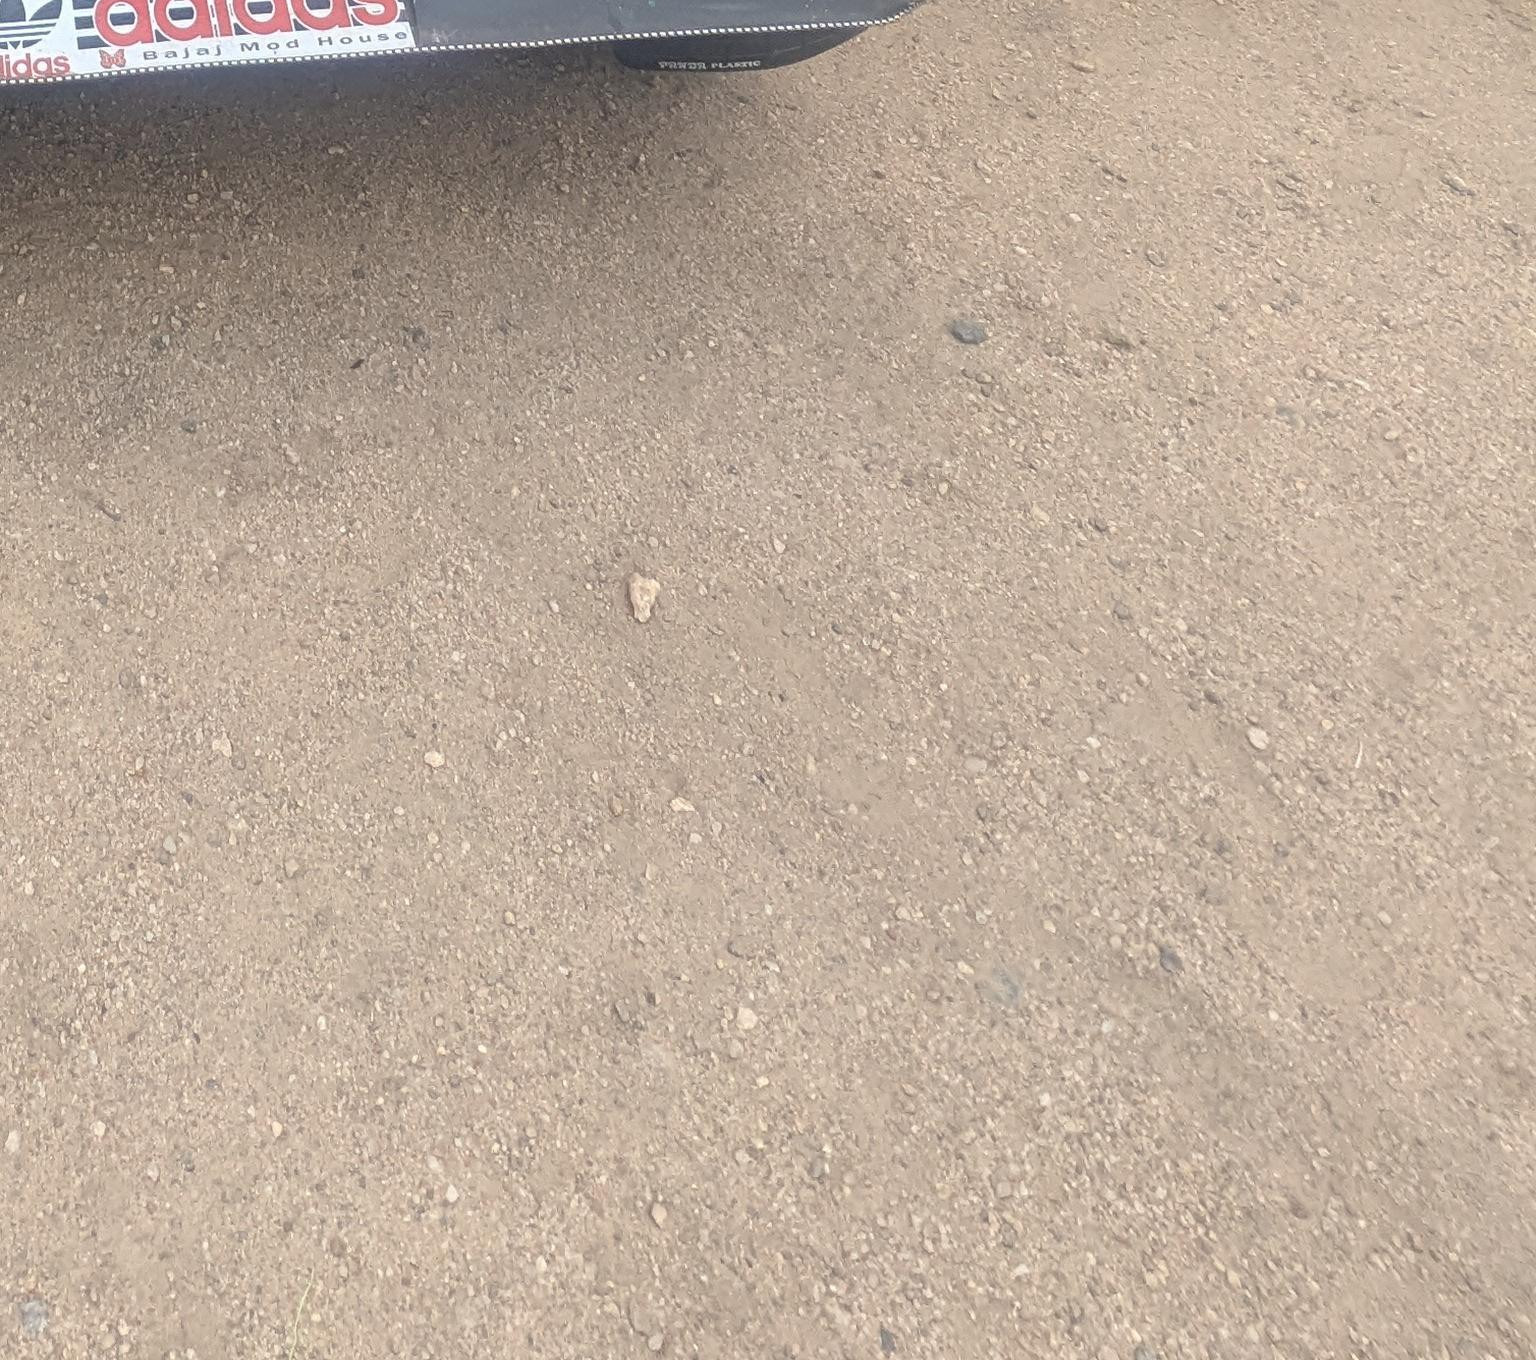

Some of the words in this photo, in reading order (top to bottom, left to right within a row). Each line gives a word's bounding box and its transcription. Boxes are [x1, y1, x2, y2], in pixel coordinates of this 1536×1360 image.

[143, 44, 222, 63] Bajaj
[240, 38, 300, 54] Mod
[317, 30, 408, 47] House
